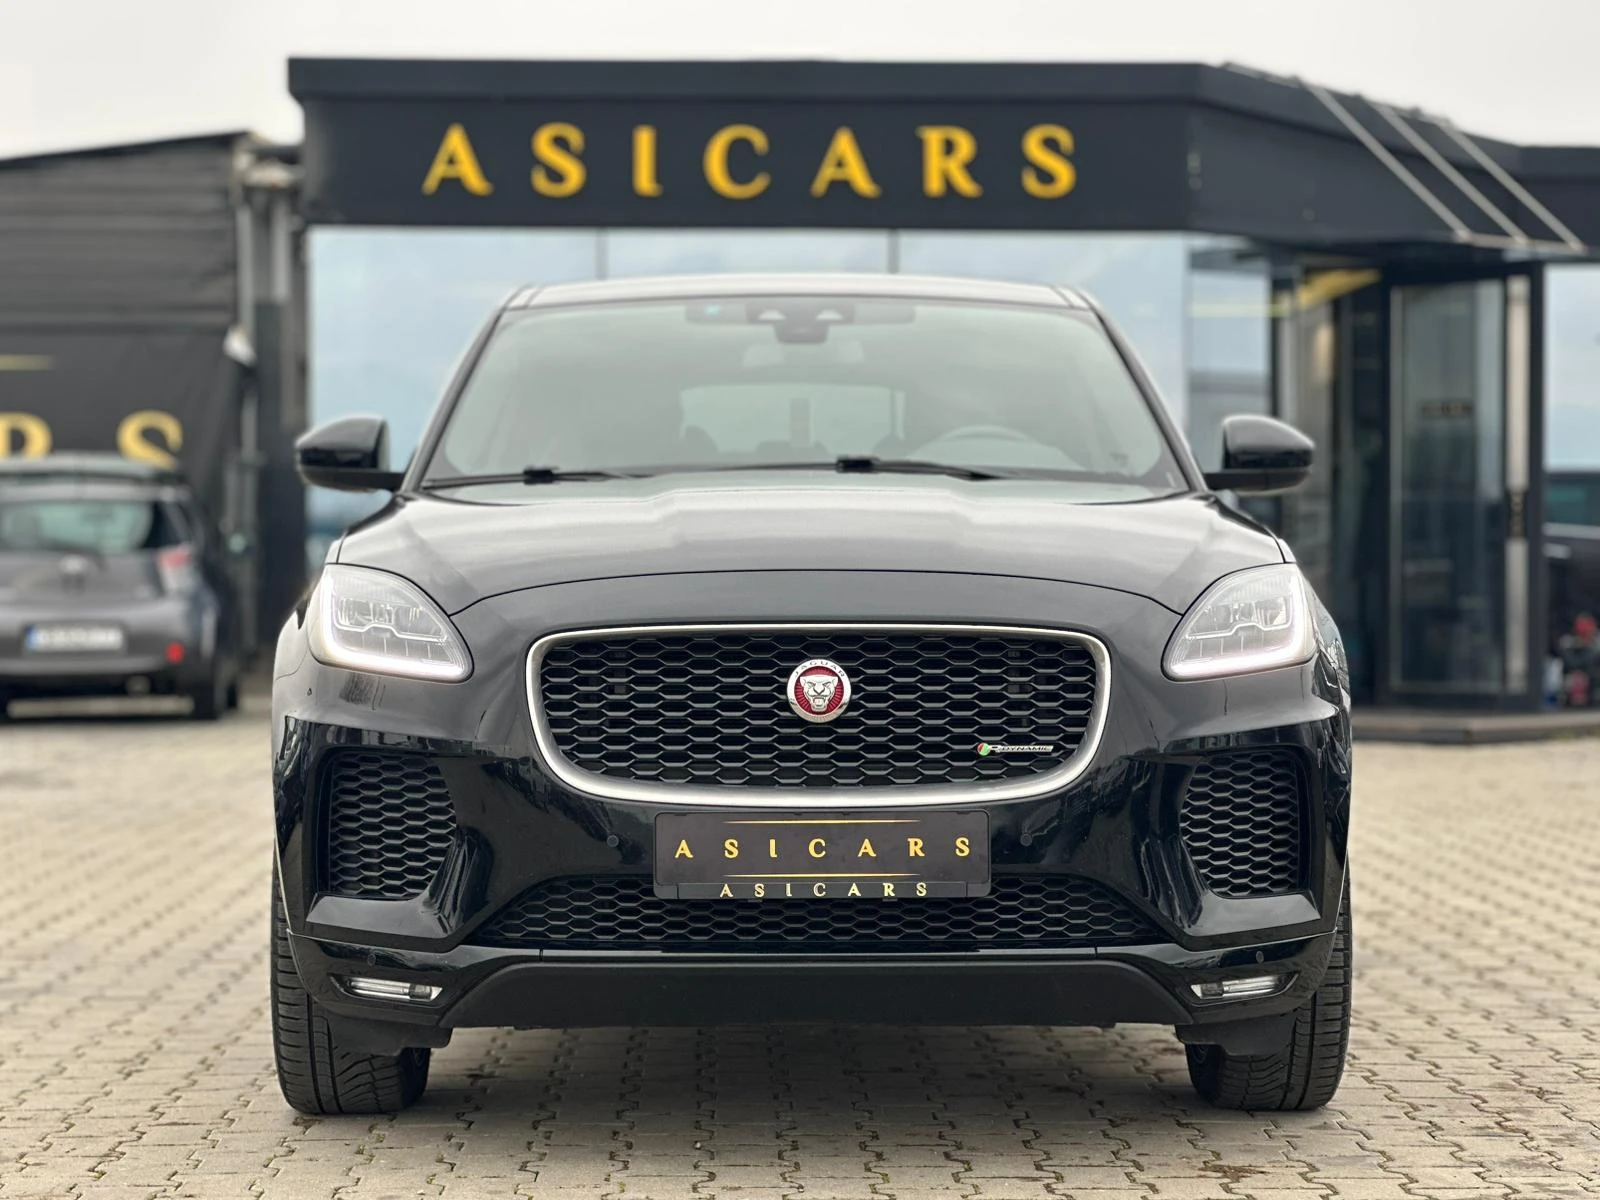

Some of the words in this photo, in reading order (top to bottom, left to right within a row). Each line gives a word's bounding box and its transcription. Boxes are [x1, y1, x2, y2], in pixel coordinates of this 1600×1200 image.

[421, 122, 1077, 199] ASICARS
[795, 660, 845, 678] JAGUAR
[674, 837, 971, 859] ASICARS
[719, 882, 928, 898] ASICARS
